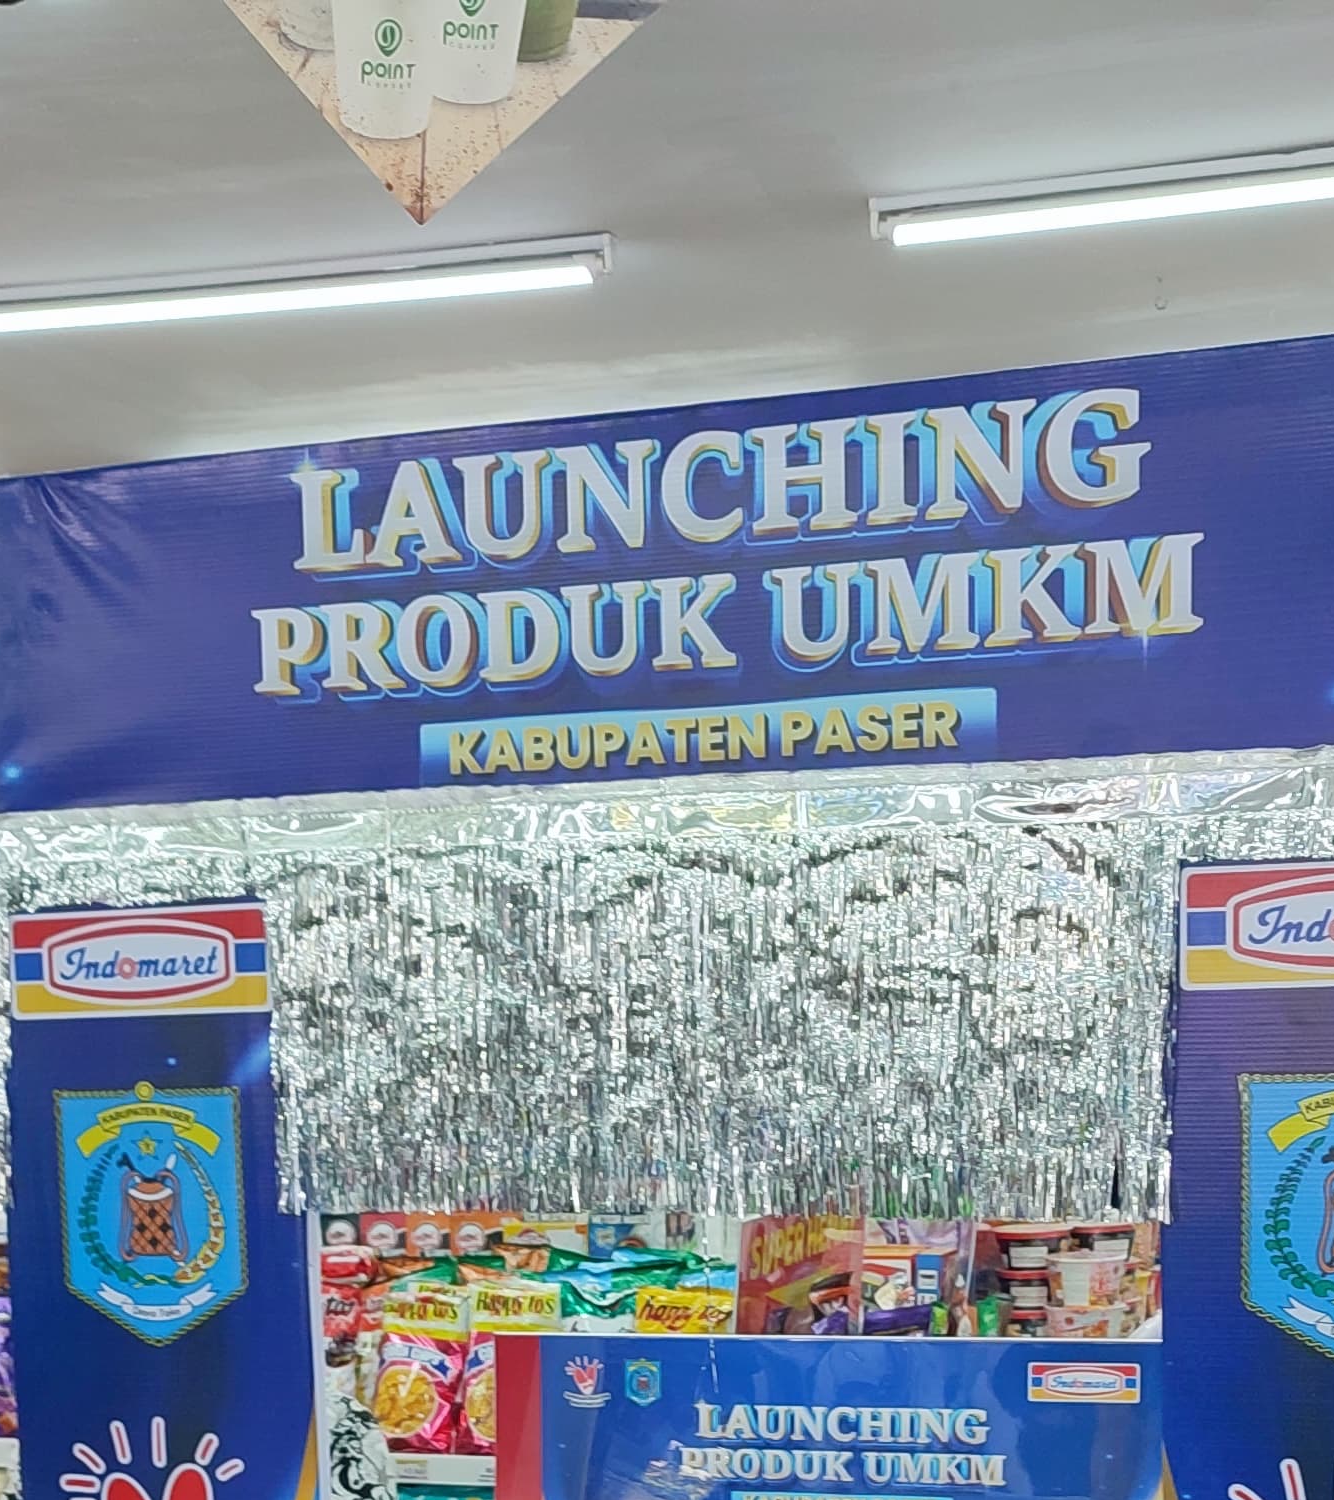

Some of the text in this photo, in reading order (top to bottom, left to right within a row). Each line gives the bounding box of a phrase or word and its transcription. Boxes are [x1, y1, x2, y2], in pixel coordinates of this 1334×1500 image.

[290, 387, 1153, 574] LAUNCHING
[253, 531, 1207, 702] PRODUK UMKM
[448, 700, 959, 776] KABUPATEN PASER
[59, 943, 221, 984] Indomaret
[695, 1403, 991, 1447] LAUNCHING
[680, 1446, 1007, 1487] PRODUK UMKM
